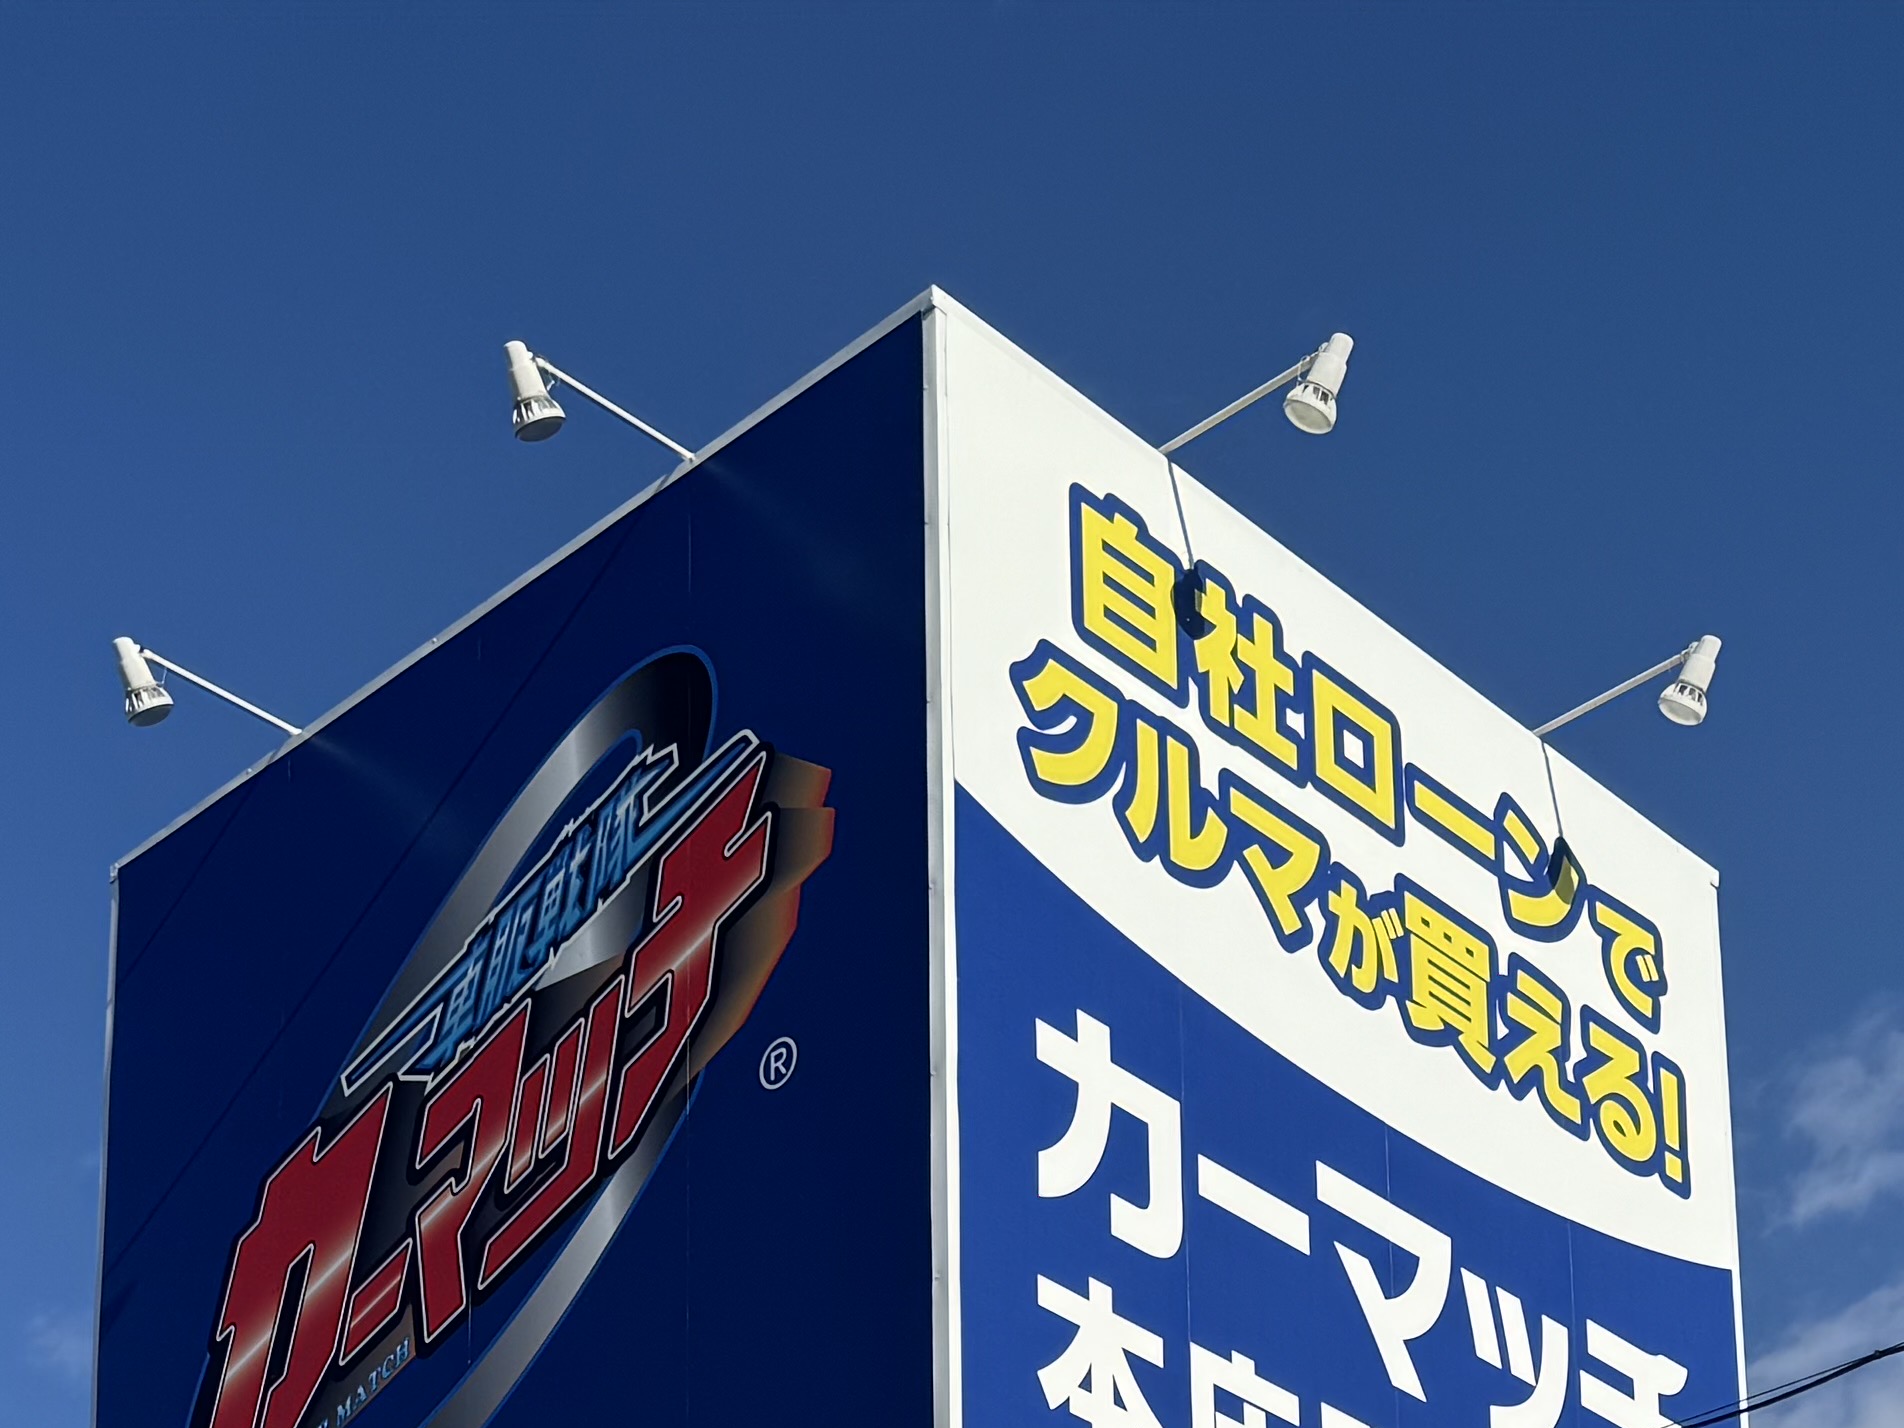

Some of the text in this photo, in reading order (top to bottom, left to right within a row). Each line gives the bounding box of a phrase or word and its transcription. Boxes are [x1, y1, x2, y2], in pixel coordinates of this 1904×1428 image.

[1013, 640, 1690, 1193] クルマが買える!
[1070, 482, 1668, 1018] 自社ローンで
[335, 1336, 411, 1428] MATCH
